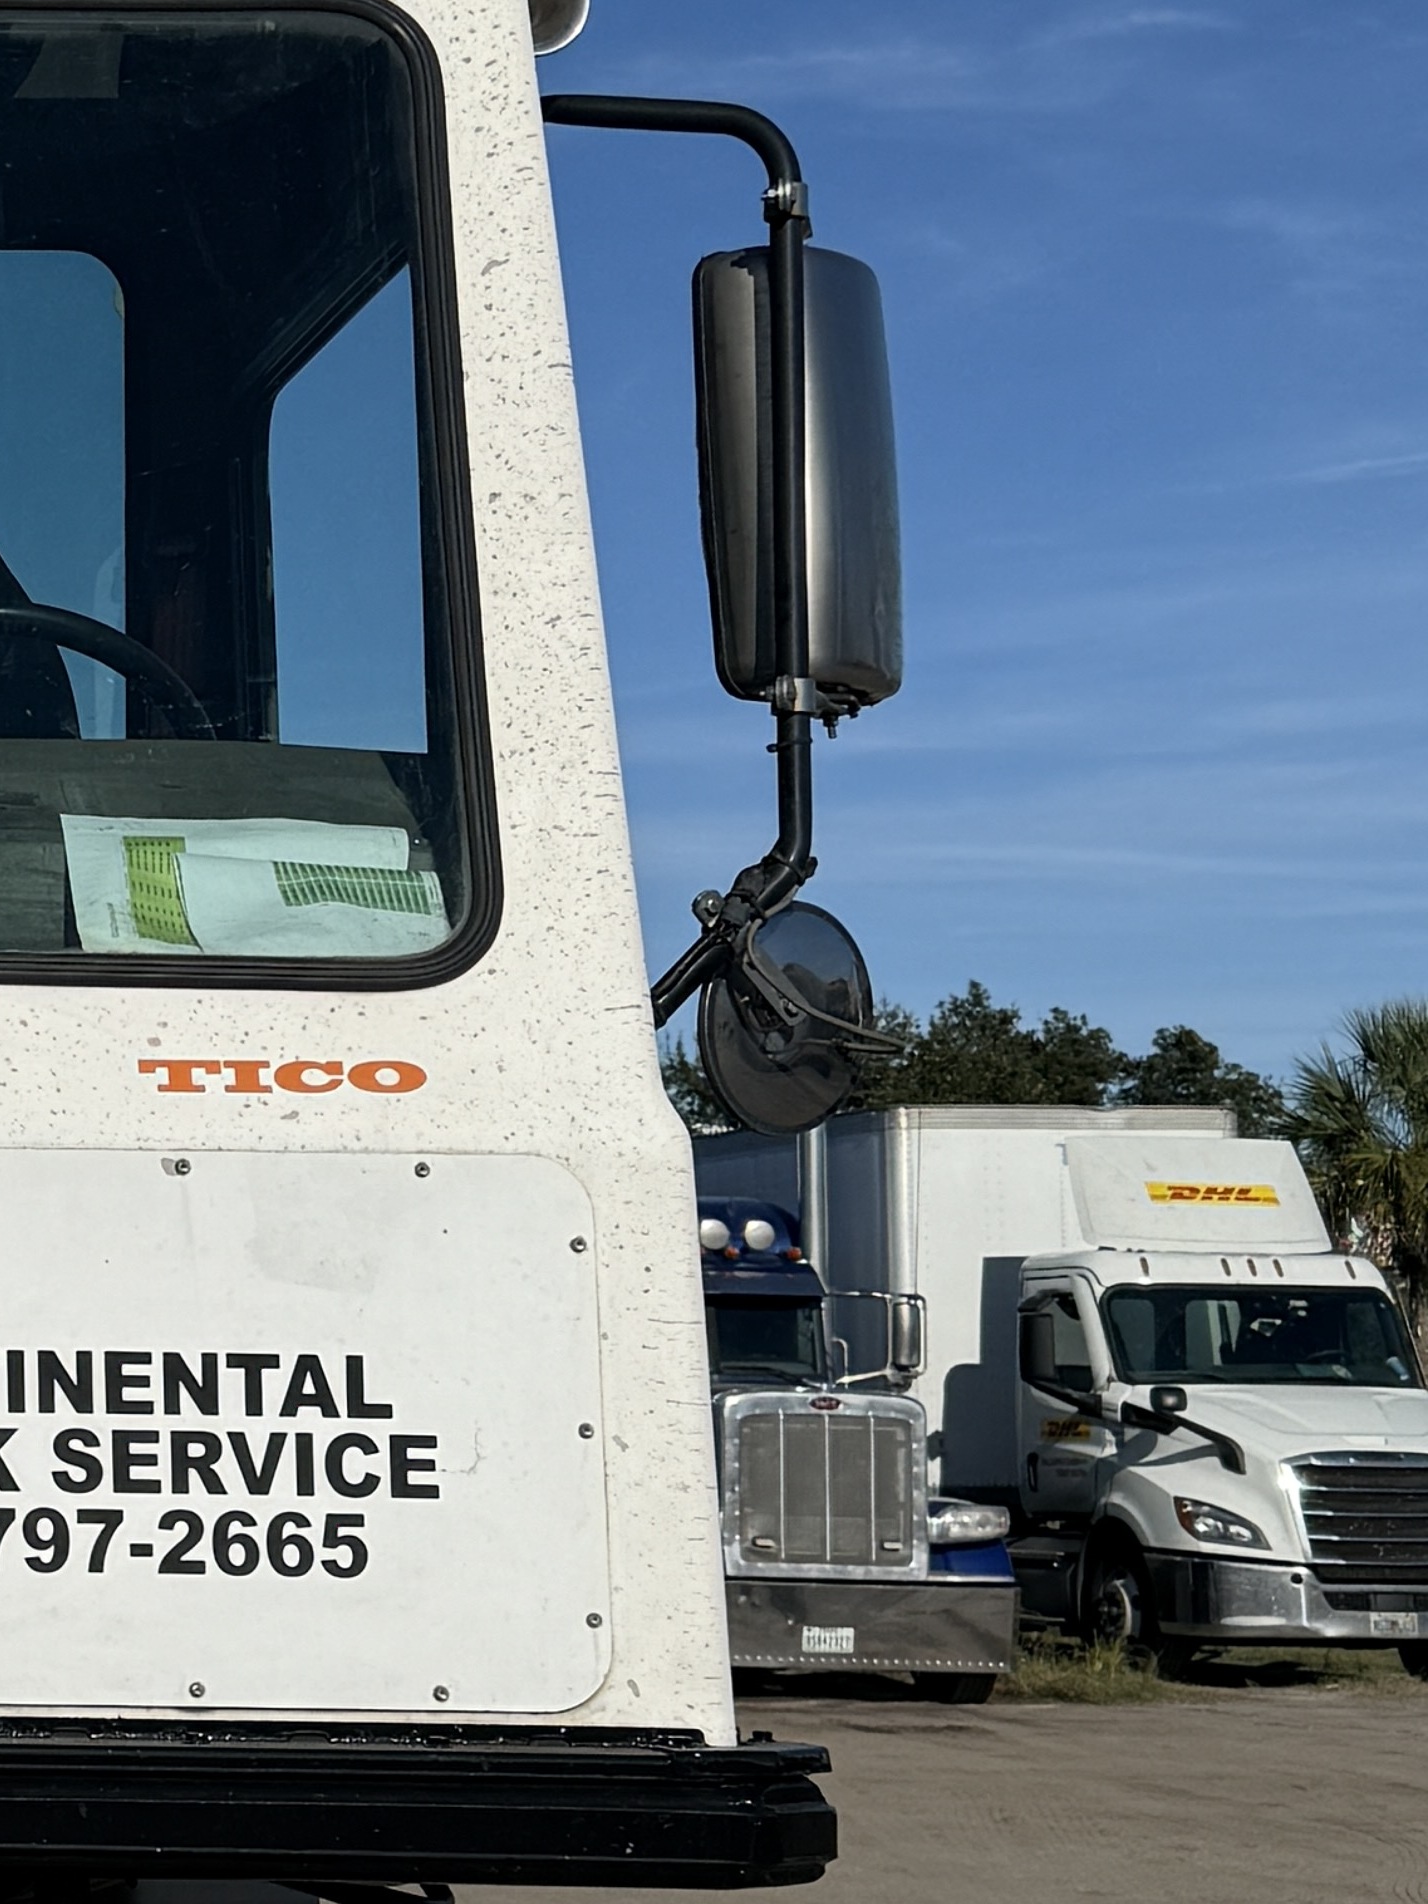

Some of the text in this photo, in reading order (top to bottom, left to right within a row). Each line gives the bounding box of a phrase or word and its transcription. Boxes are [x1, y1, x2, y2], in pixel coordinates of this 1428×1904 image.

[138, 1059, 427, 1094] TICO
[1167, 1186, 1261, 1201] DHL
[51, 1428, 440, 1499] SERVICE
